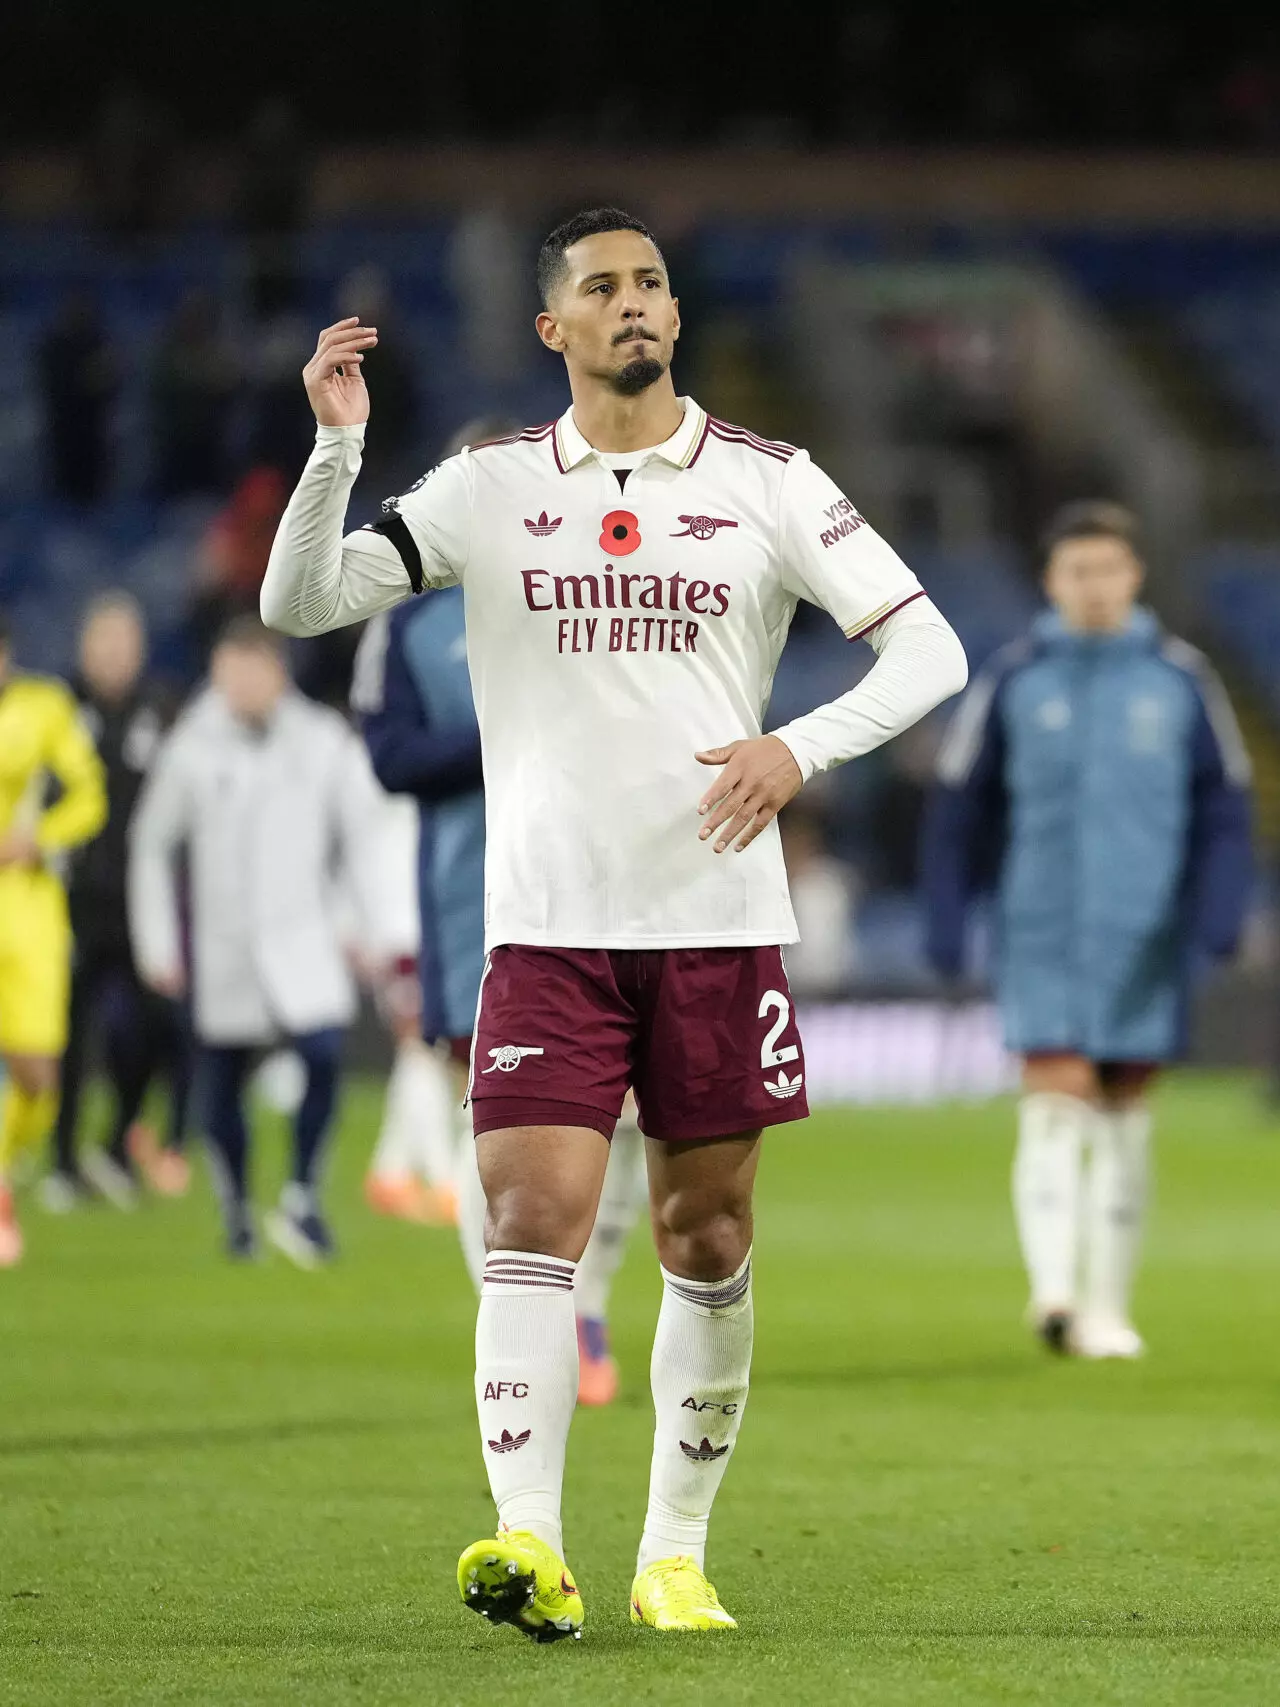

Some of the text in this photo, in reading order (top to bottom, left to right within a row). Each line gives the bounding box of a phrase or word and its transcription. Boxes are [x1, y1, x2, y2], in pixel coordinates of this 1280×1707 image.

[822, 498, 854, 522] VISI
[819, 513, 867, 549] RWAN
[520, 563, 731, 617] Emirates
[558, 617, 699, 654] FLY BETTER
[758, 989, 799, 1069] 2
[483, 1381, 529, 1401] AFC
[680, 1396, 738, 1416] AFC
